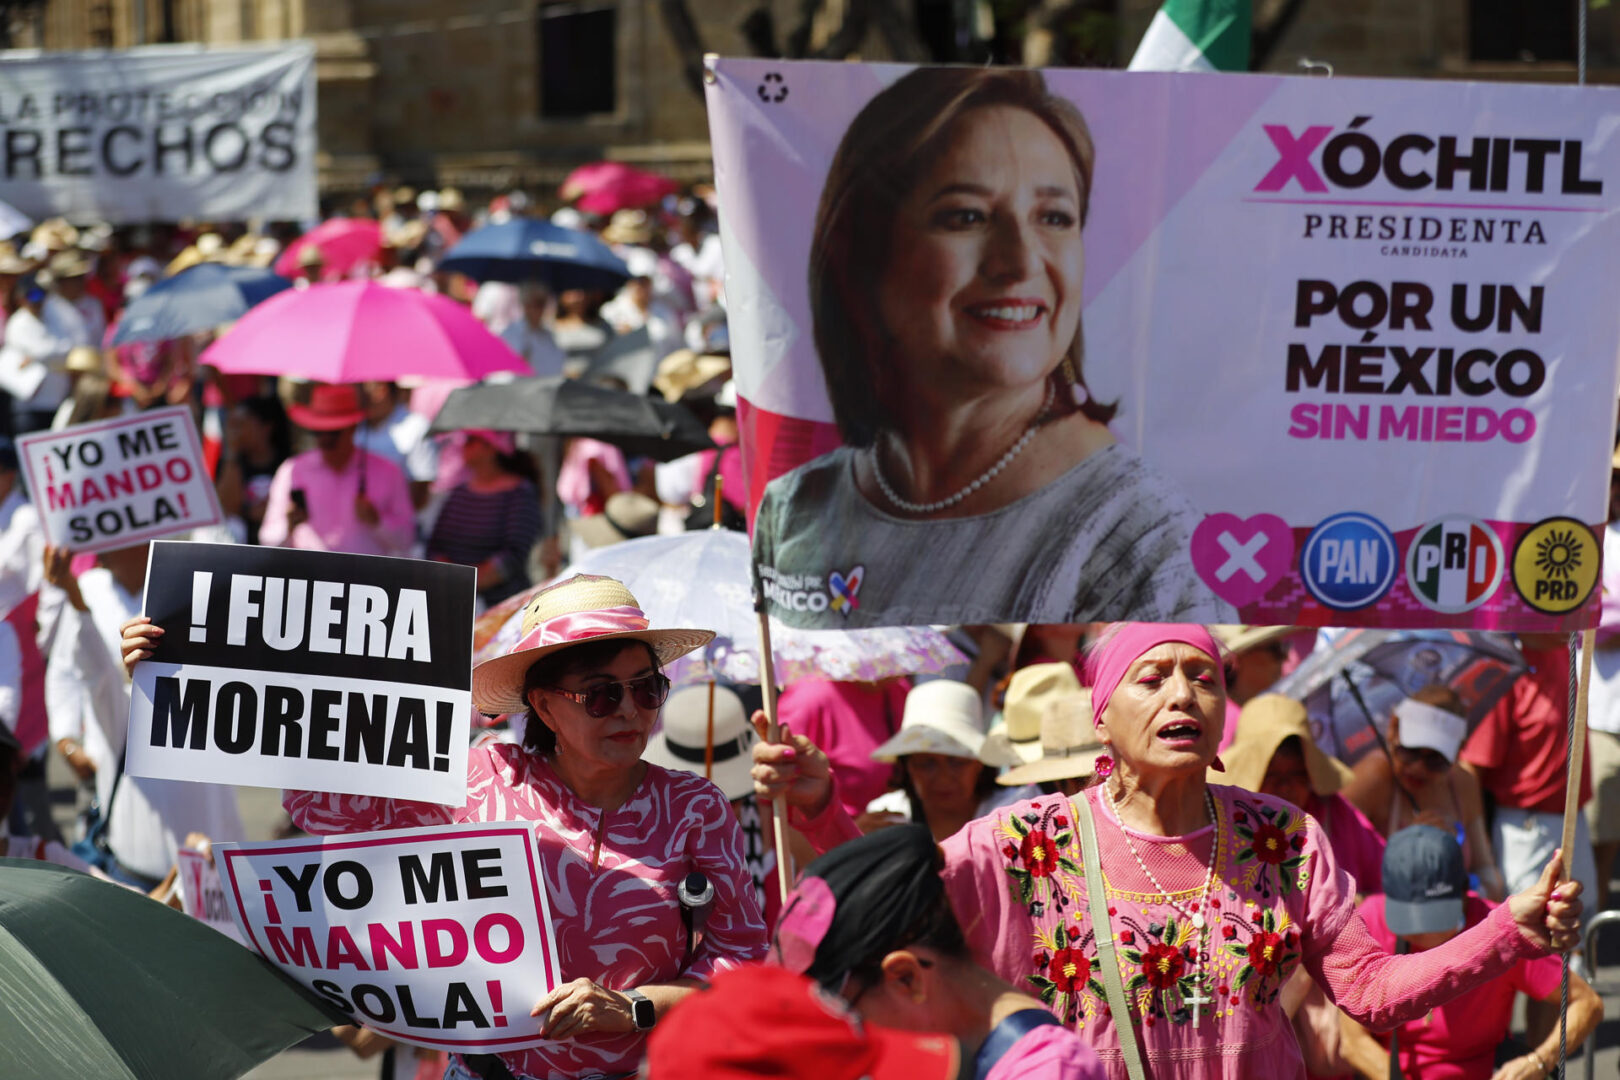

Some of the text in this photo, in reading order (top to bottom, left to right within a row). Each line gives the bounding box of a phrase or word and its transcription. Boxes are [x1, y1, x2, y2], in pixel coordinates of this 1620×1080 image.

[1252, 115, 1603, 195] XÓCHITL
[1302, 214, 1548, 245] PRESIDENTA
[1380, 246, 1469, 258] CANDIDATA
[1294, 279, 1545, 333] POR UN
[1285, 331, 1546, 397] MÉXICO
[117, 423, 179, 459] ME
[1287, 402, 1538, 443] SIN MIEDO
[46, 457, 193, 512] MANDO
[69, 493, 190, 543] SOLA!
[1318, 538, 1379, 585] PAN
[1416, 532, 1487, 584] PRI
[1534, 578, 1579, 601] PRD
[149, 676, 455, 773] MORENA!
[258, 860, 374, 925] ¡YO
[399, 848, 508, 905] ME
[264, 912, 525, 971] MANDO
[312, 979, 508, 1029] SOLA!
